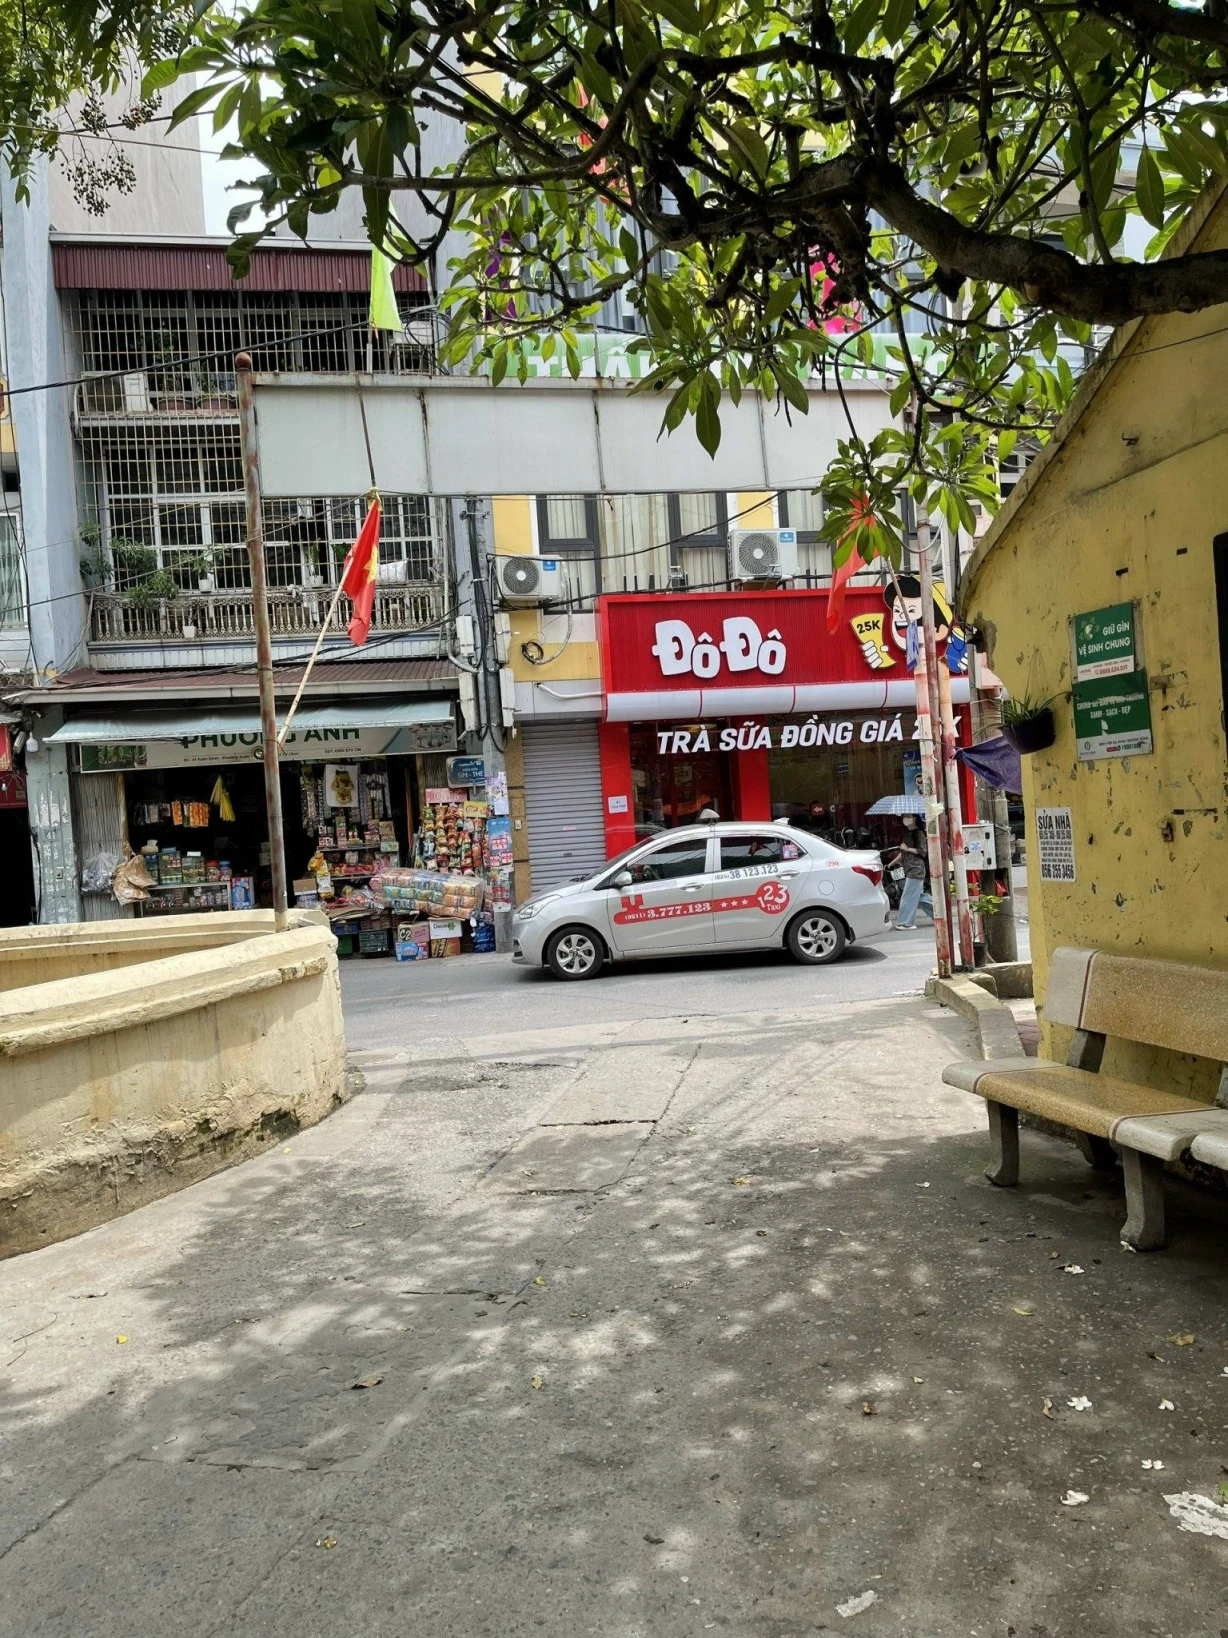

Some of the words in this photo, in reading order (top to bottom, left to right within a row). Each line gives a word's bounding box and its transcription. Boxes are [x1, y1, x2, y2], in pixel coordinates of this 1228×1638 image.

[856, 619, 881, 635] 25K
[1078, 643, 1087, 657] VỆ
[1087, 642, 1104, 655] SINH
[1104, 636, 1131, 651] CHUNG
[657, 724, 711, 754] TRÀ
[719, 720, 773, 750] SỮA
[781, 714, 854, 749] ĐỒNG
[860, 712, 904, 743] GIÁ
[1037, 809, 1054, 830] SỬA
[1054, 811, 1071, 830] NHÀ
[647, 902, 711, 918] 3.777.123
[766, 903, 781, 911] Taxi
